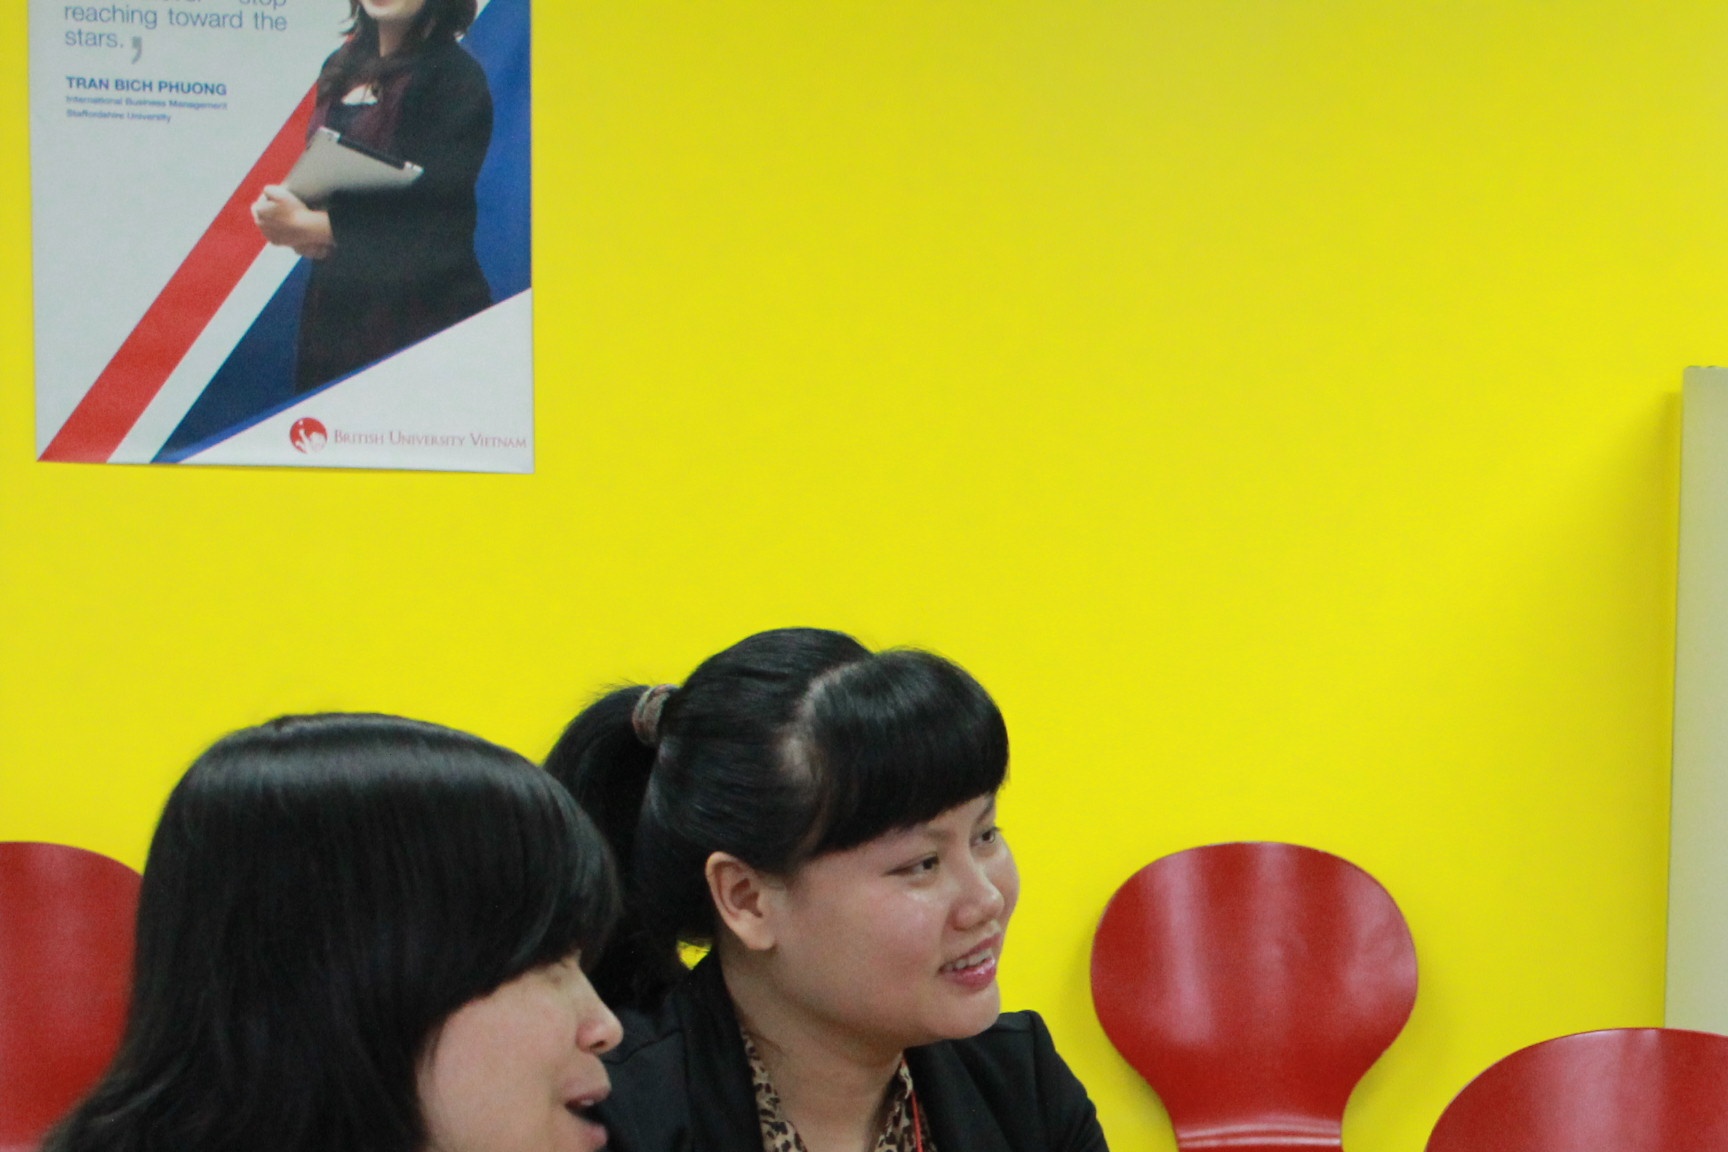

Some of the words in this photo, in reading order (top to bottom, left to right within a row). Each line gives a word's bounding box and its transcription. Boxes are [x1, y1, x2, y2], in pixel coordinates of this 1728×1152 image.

[64, 4, 158, 30] reaching
[168, 8, 243, 29] toward
[253, 10, 287, 31] the
[64, 29, 124, 49] stars.
[66, 76, 109, 91] TRAN
[114, 79, 153, 93] BICH
[158, 81, 227, 96] PHUONG
[66, 95, 123, 106] International
[125, 98, 166, 107] Business
[169, 100, 227, 111] Management
[127, 112, 171, 124] University
[334, 429, 384, 445] BRITISH
[389, 430, 465, 447] UNIVERSITY
[470, 432, 527, 449] VIETNAM
